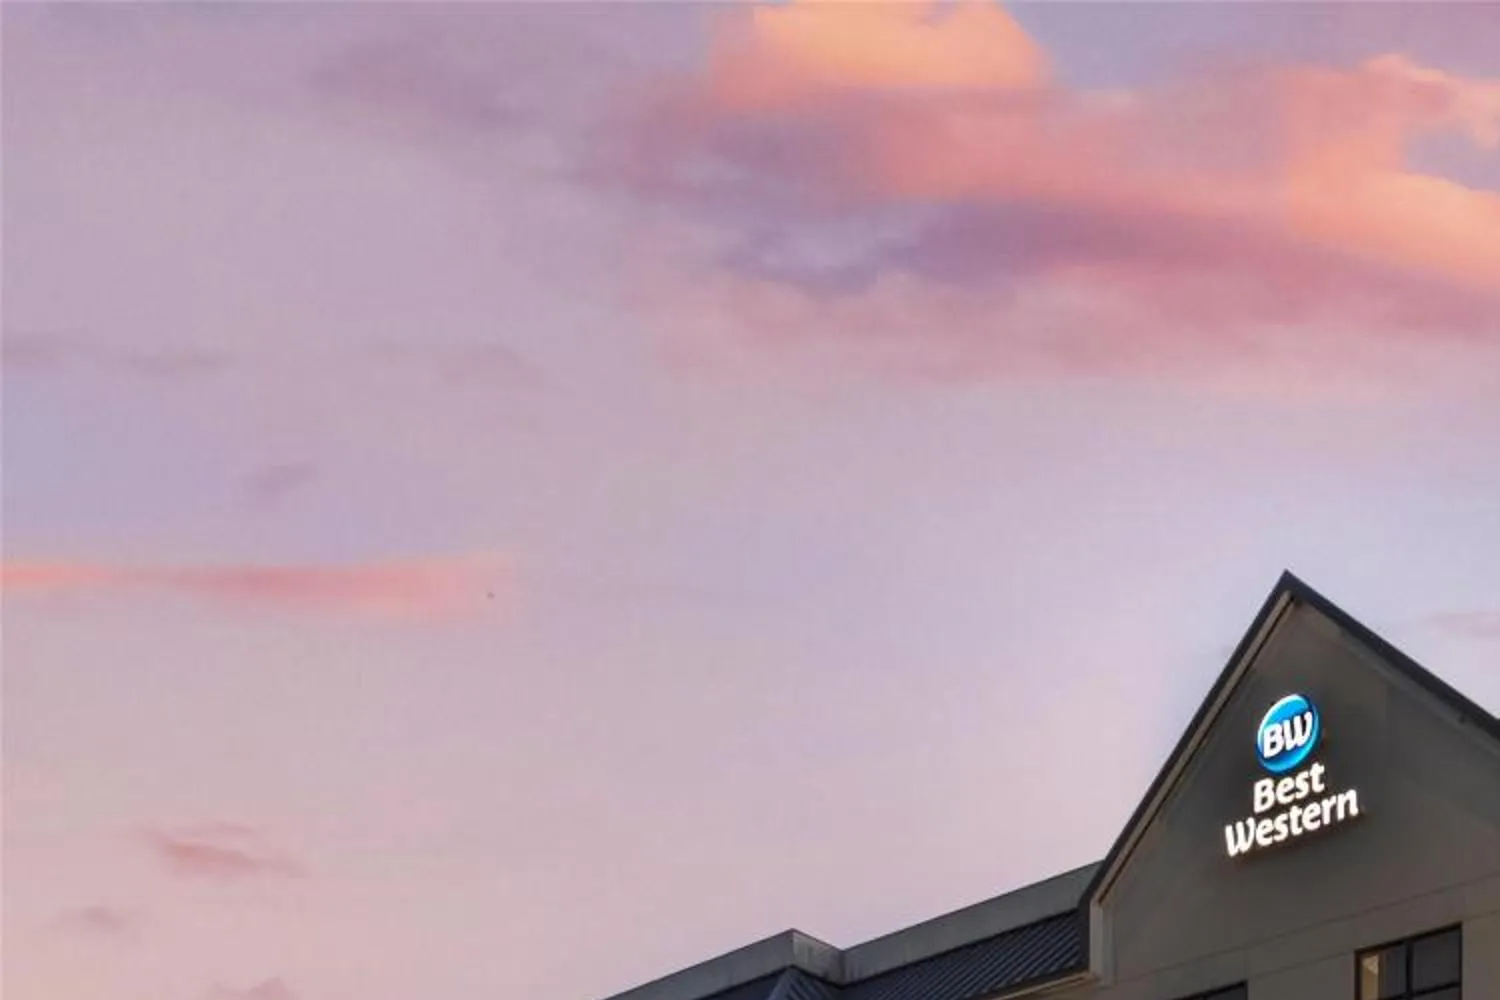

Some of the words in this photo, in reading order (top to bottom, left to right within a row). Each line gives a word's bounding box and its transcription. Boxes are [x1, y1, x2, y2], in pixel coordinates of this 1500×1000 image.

[1263, 711, 1313, 758] BW
[1253, 761, 1325, 813] Best
[1225, 788, 1359, 857] Western
